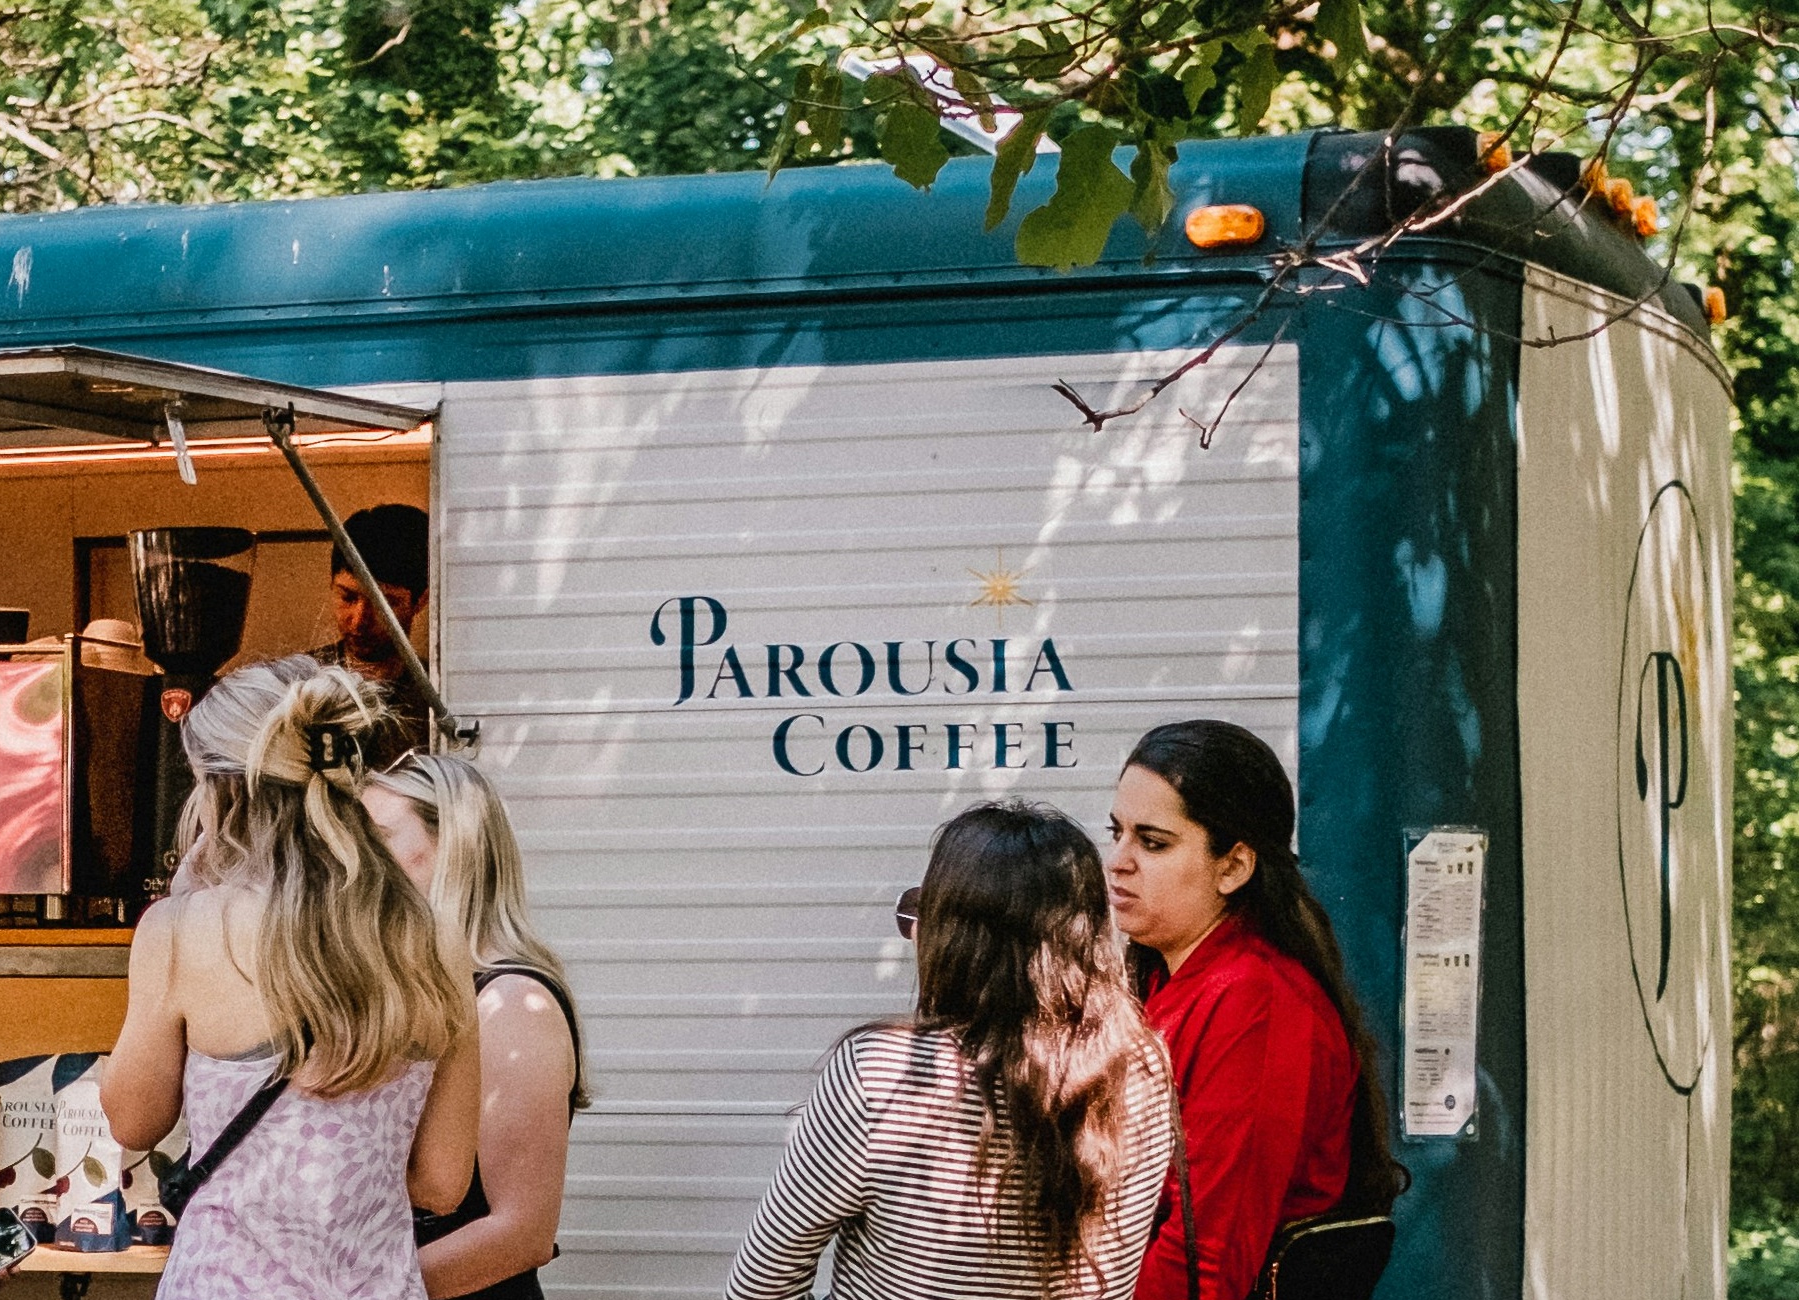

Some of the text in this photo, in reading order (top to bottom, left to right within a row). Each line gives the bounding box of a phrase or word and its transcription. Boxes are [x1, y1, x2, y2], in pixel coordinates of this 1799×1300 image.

[649, 596, 1075, 706] PAROUSIA
[773, 713, 1078, 776] COFFEE
[2, 1114, 56, 1130] COFFEE
[4, 1101, 56, 1114] ROUSIA
